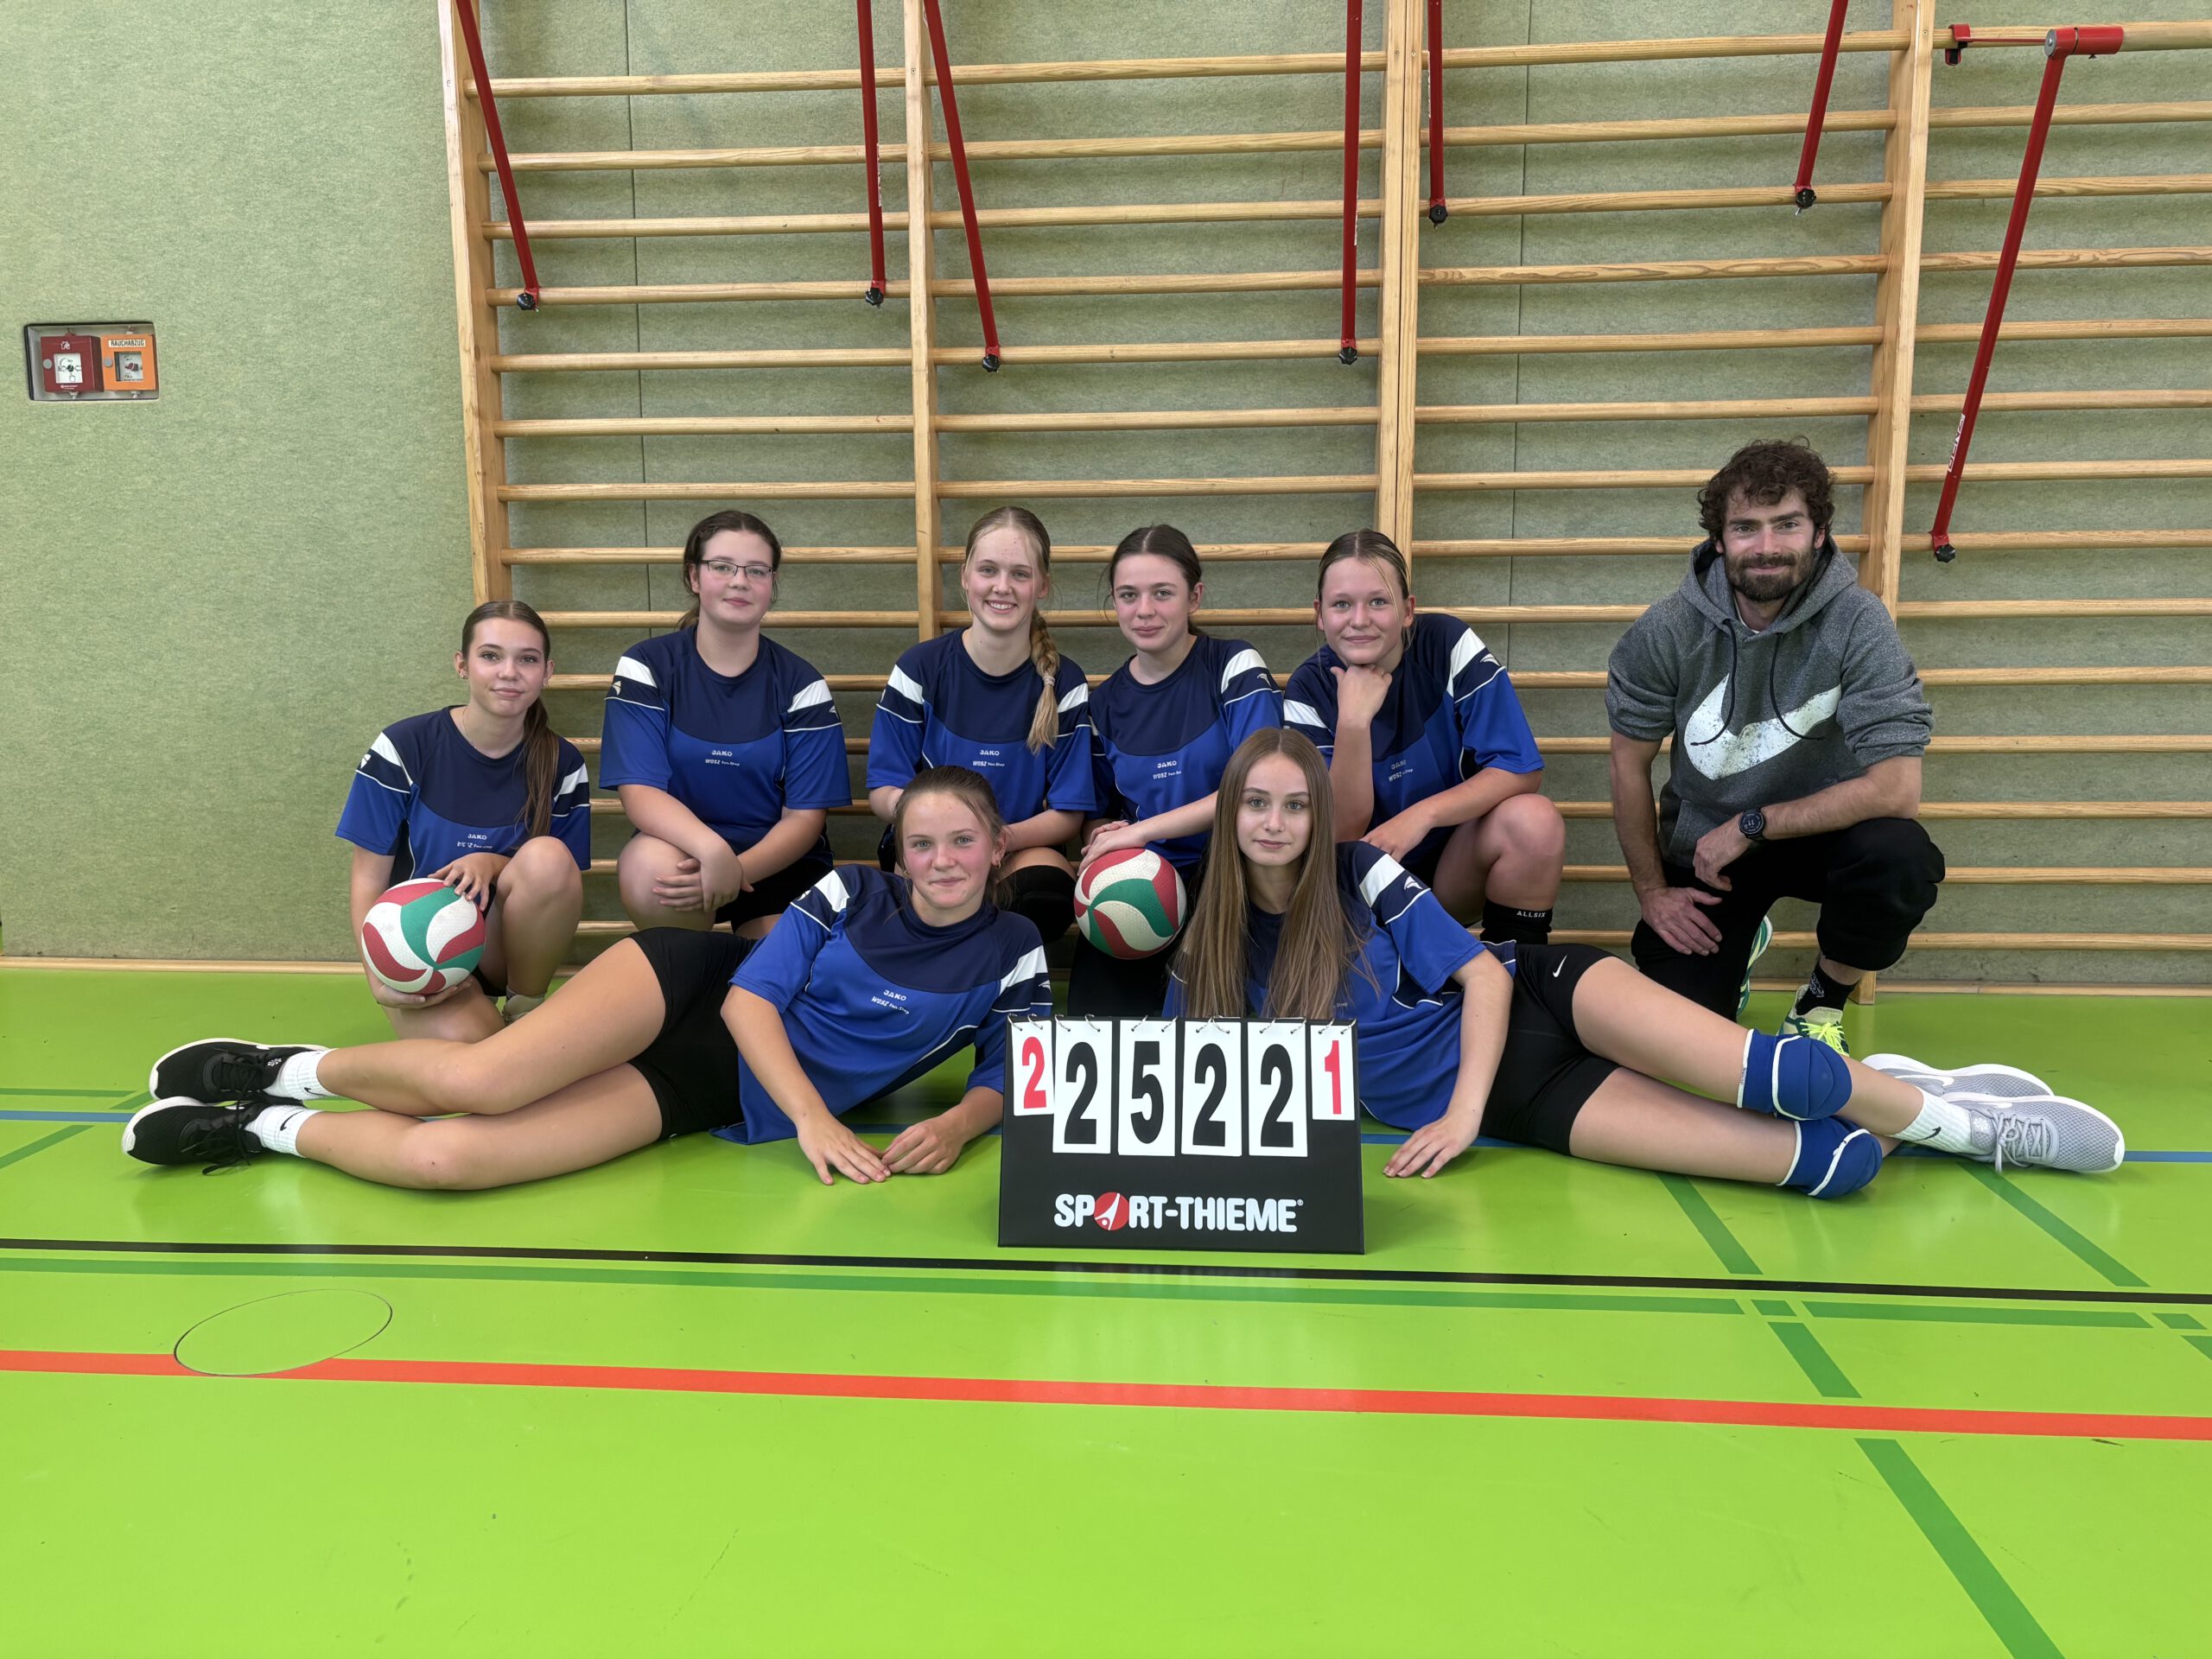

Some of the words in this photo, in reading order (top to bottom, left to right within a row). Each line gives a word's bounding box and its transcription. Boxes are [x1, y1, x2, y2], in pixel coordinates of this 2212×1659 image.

[1157, 760, 1177, 769] JAKO
[883, 989, 907, 1001] JAKO
[1021, 1036, 1047, 1109] 2
[1064, 1041, 1098, 1145] 2
[1130, 1040, 1164, 1144] 5
[1192, 1043, 1227, 1147] 2
[1260, 1044, 1294, 1147] 2
[1324, 1039, 1342, 1115] 1
